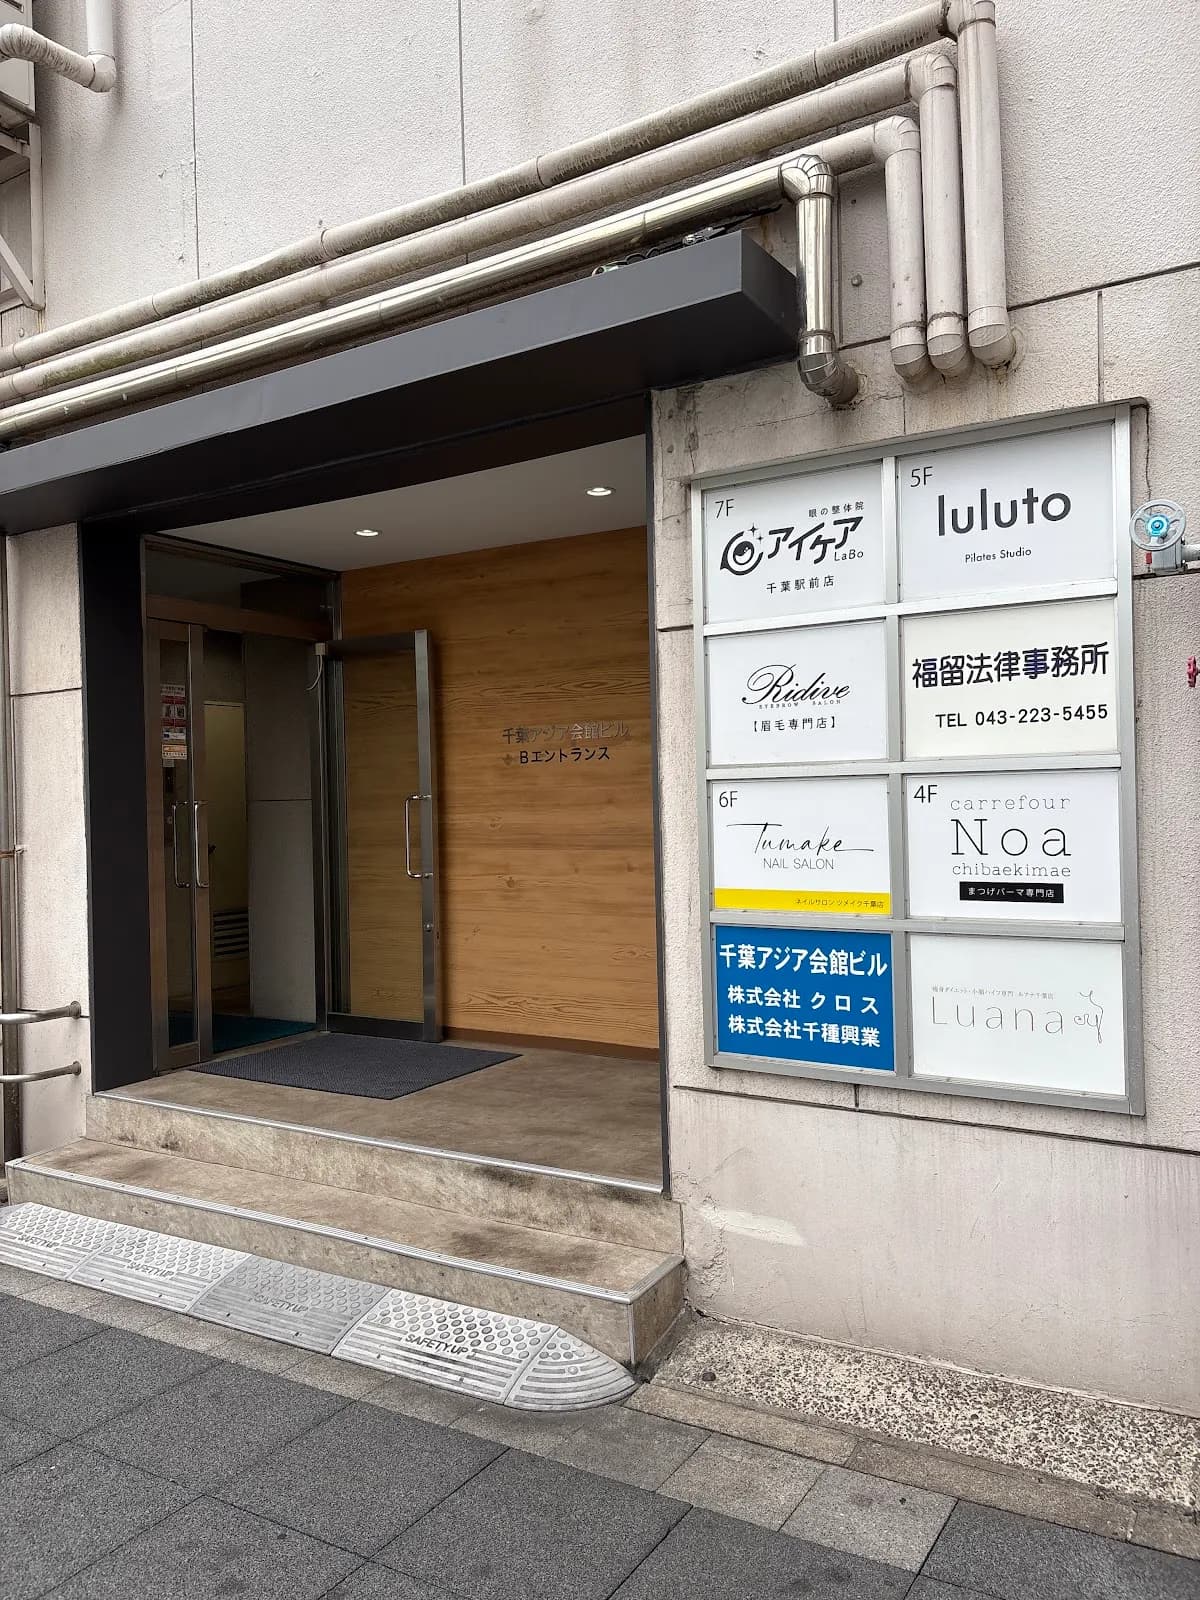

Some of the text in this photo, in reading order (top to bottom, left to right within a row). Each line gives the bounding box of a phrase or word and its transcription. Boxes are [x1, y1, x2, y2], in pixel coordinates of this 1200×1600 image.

[910, 466, 934, 487] 5F
[715, 498, 735, 518] 7F
[808, 501, 864, 518] 眼の整体院
[938, 487, 1071, 536] luluto
[767, 516, 863, 564] アイケア
[834, 550, 864, 561] LaBo
[965, 547, 1032, 563] Pilates Studio
[766, 575, 835, 594] 千葉駅前店
[912, 641, 1109, 689] 福留法律事務所
[741, 664, 851, 705] Ridive
[935, 704, 1108, 728] TEL 043-223-5455
[502, 719, 629, 744] 千葉アジア会館ビル
[520, 747, 610, 764] Bエントランス
[718, 790, 738, 808] 6F
[913, 785, 938, 804] 4F
[950, 795, 1071, 811] carrefour
[950, 818, 1071, 857] Noa
[763, 857, 834, 870] NAIL SALON
[952, 863, 1071, 877] chibaekimae
[967, 887, 1055, 898] まつげパーマ専門店
[719, 943, 888, 978] 千葉アジア会館ビル
[727, 984, 879, 1015] 株式会社 クロス
[932, 996, 1064, 1035] Luana
[728, 1014, 881, 1048] 株式会社千種興業
